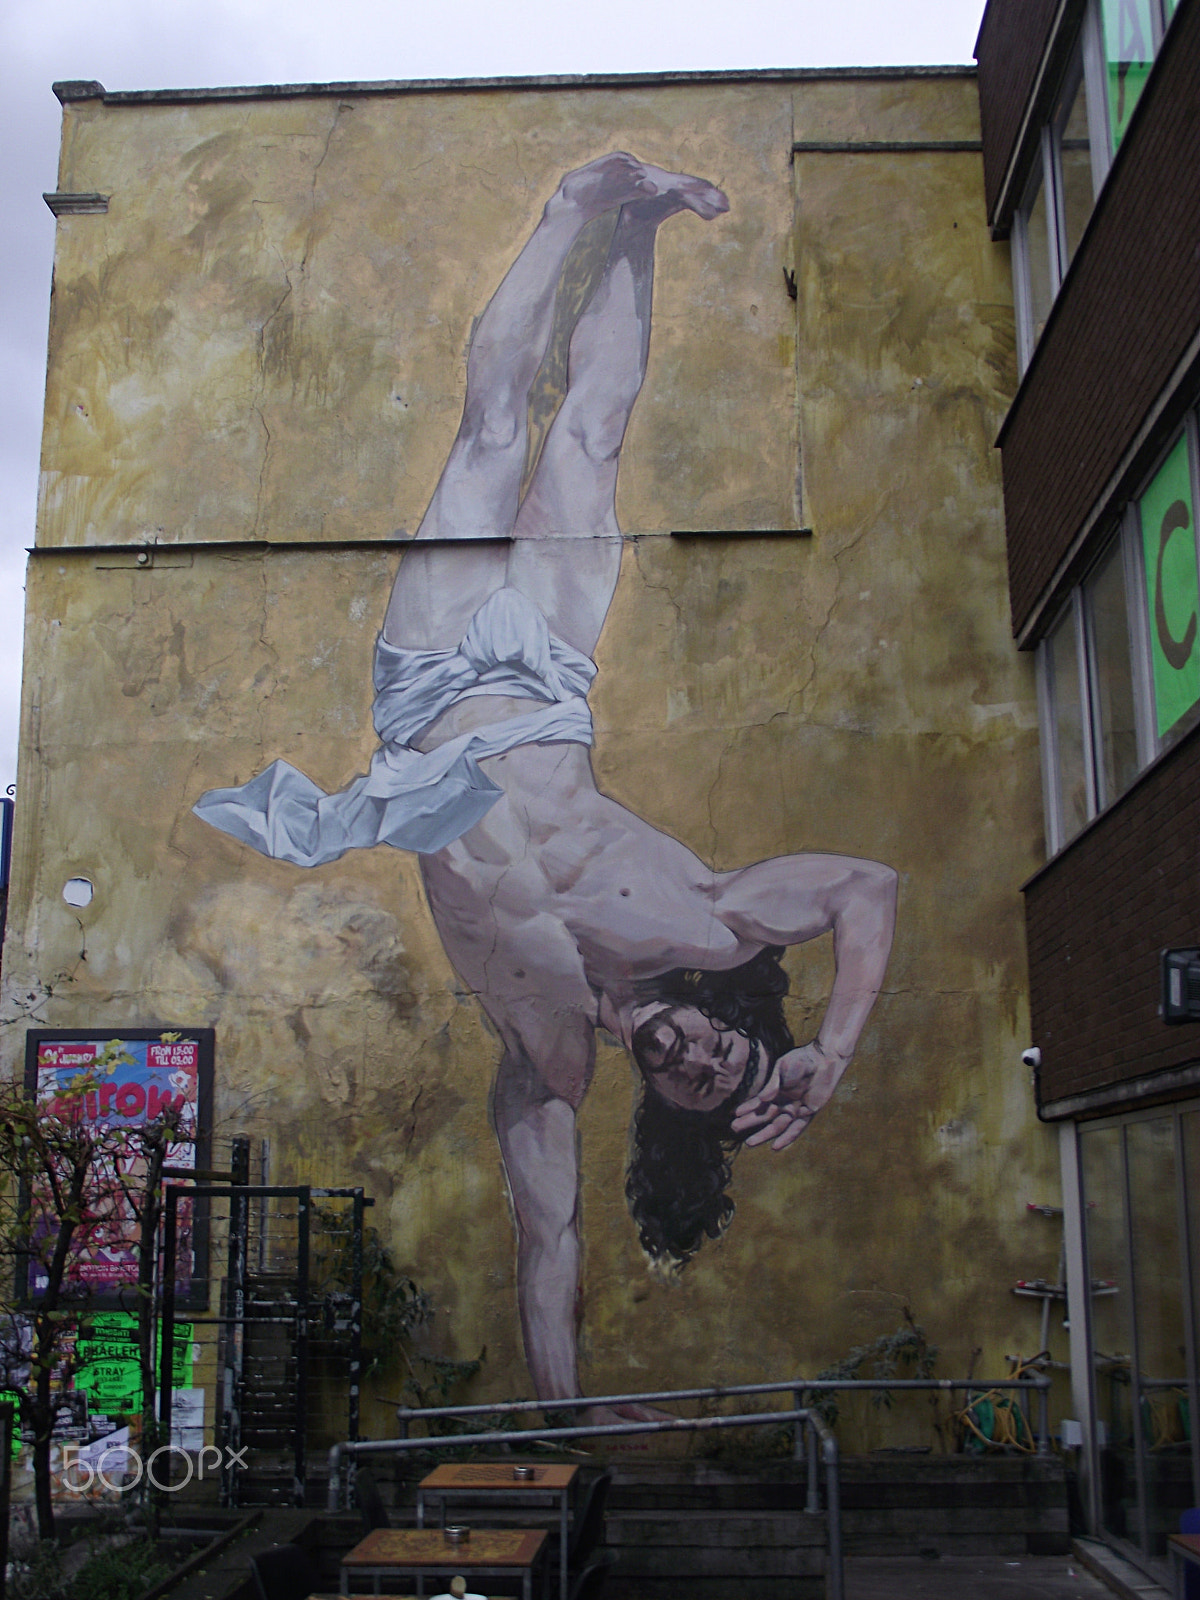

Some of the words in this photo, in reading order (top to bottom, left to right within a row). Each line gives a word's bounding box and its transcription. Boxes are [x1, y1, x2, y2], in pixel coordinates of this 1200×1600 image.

[1155, 499, 1197, 671] C
[150, 1046, 172, 1056] FROM
[155, 1056, 170, 1066] TILL
